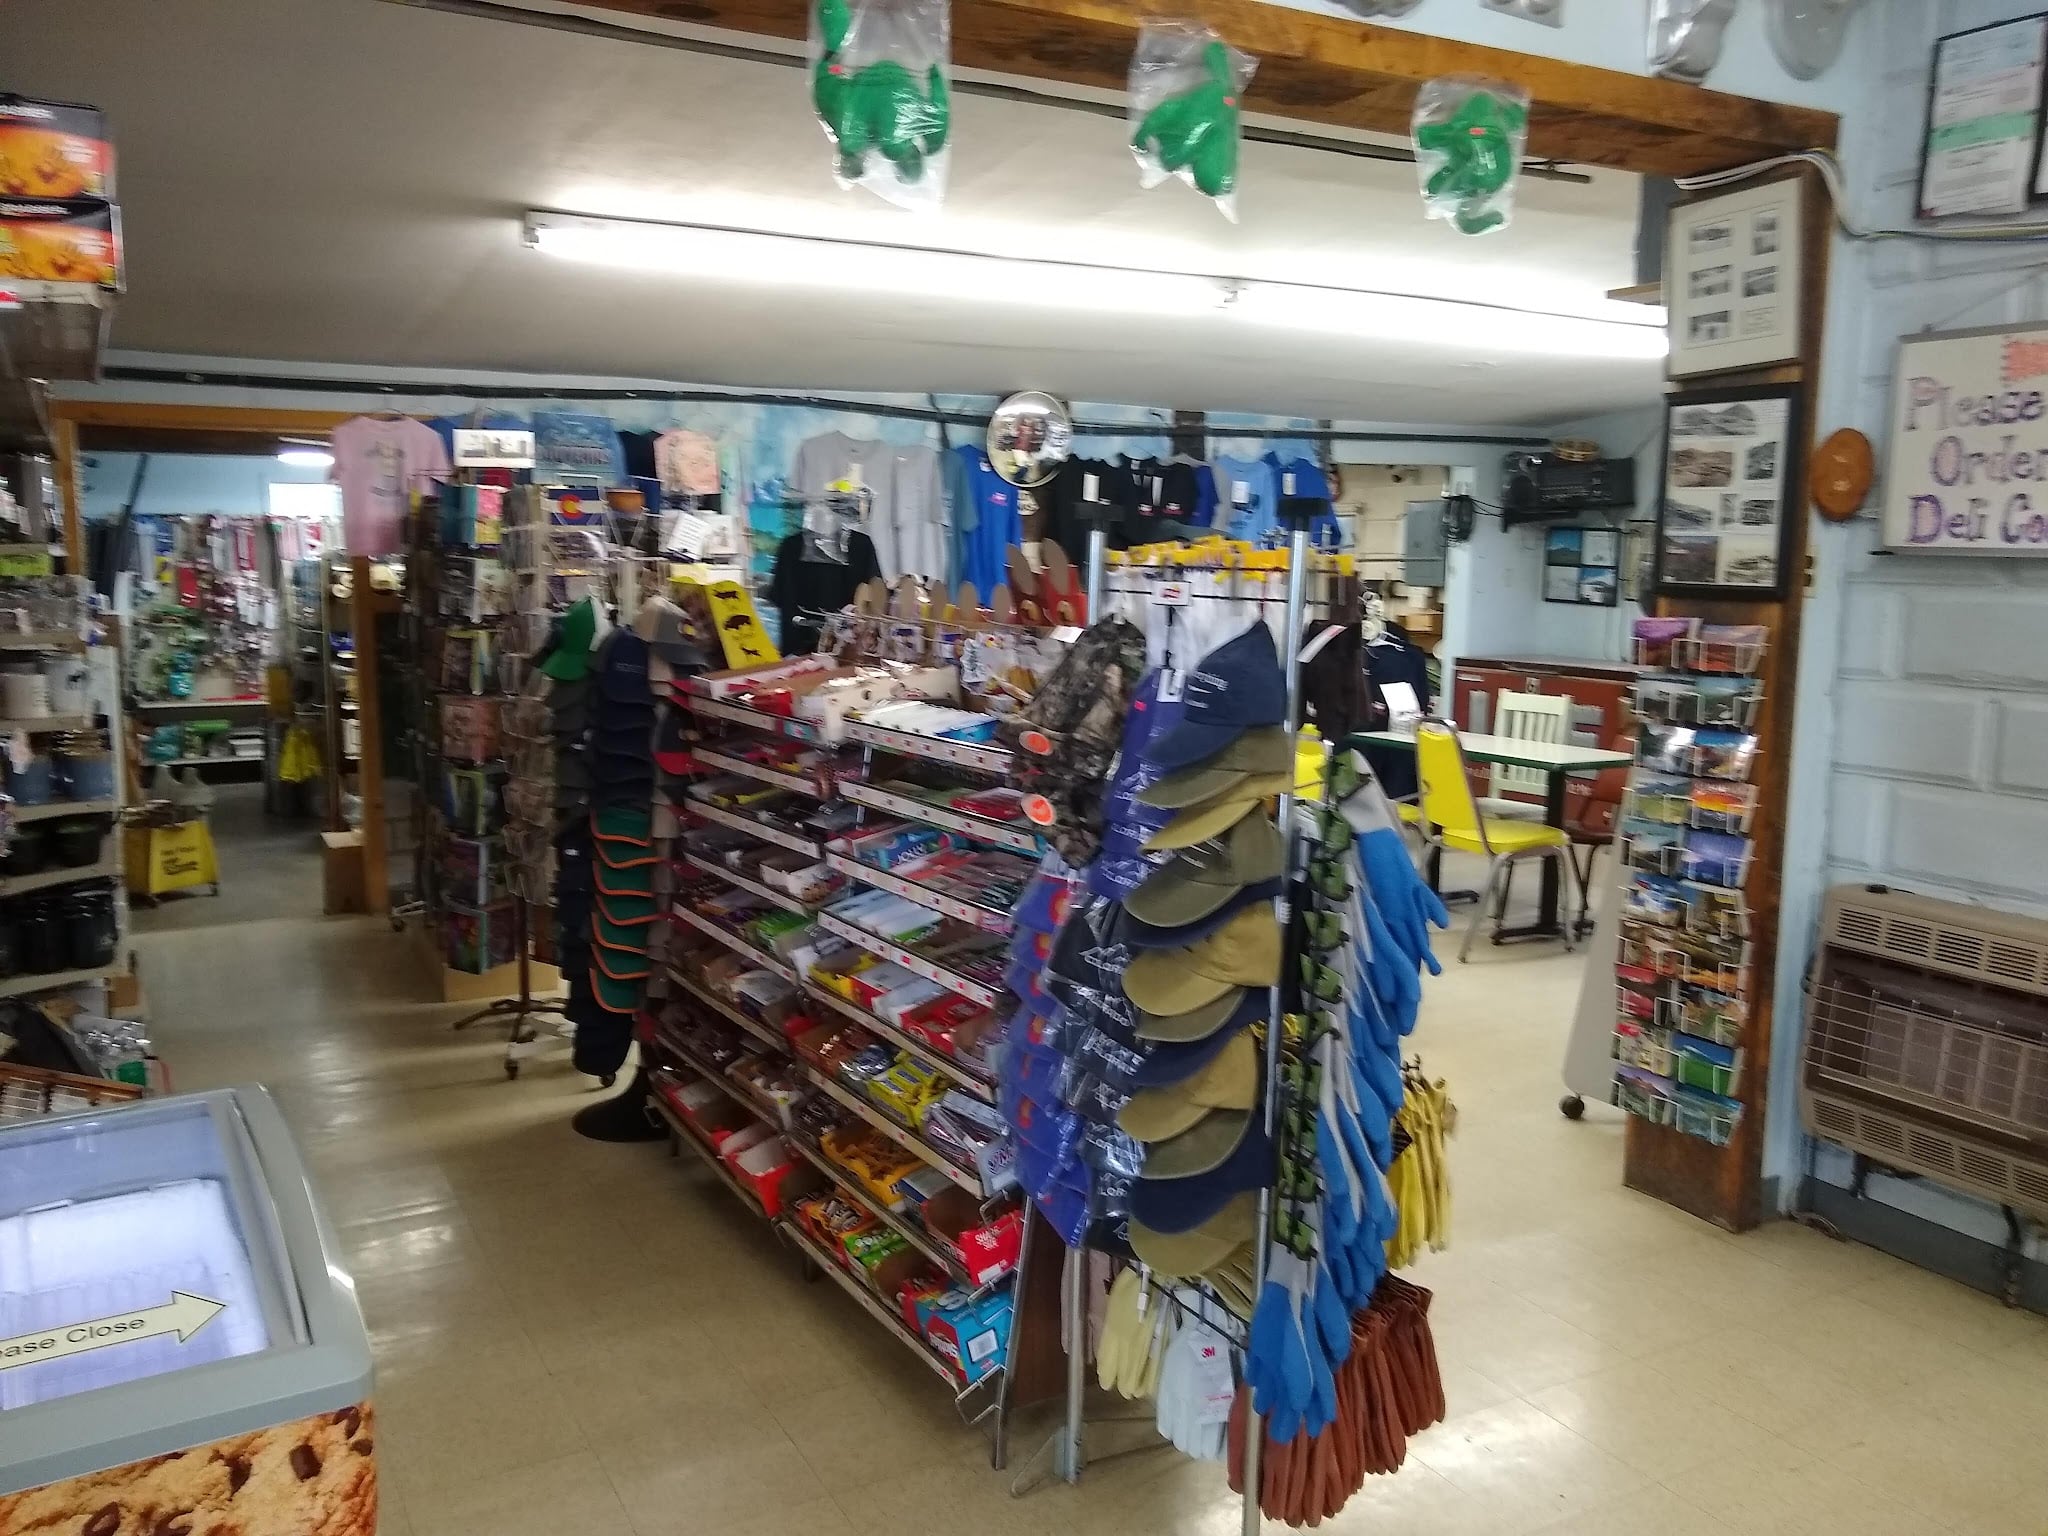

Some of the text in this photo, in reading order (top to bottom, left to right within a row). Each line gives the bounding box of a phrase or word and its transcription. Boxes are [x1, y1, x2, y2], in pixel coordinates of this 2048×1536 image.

[1904, 376, 2045, 432] Please
[1930, 435, 2048, 486] Order
[1906, 494, 1988, 542] Deli
[0, 1319, 145, 1358] ase Close
[1201, 1346, 1216, 1359] 3M
